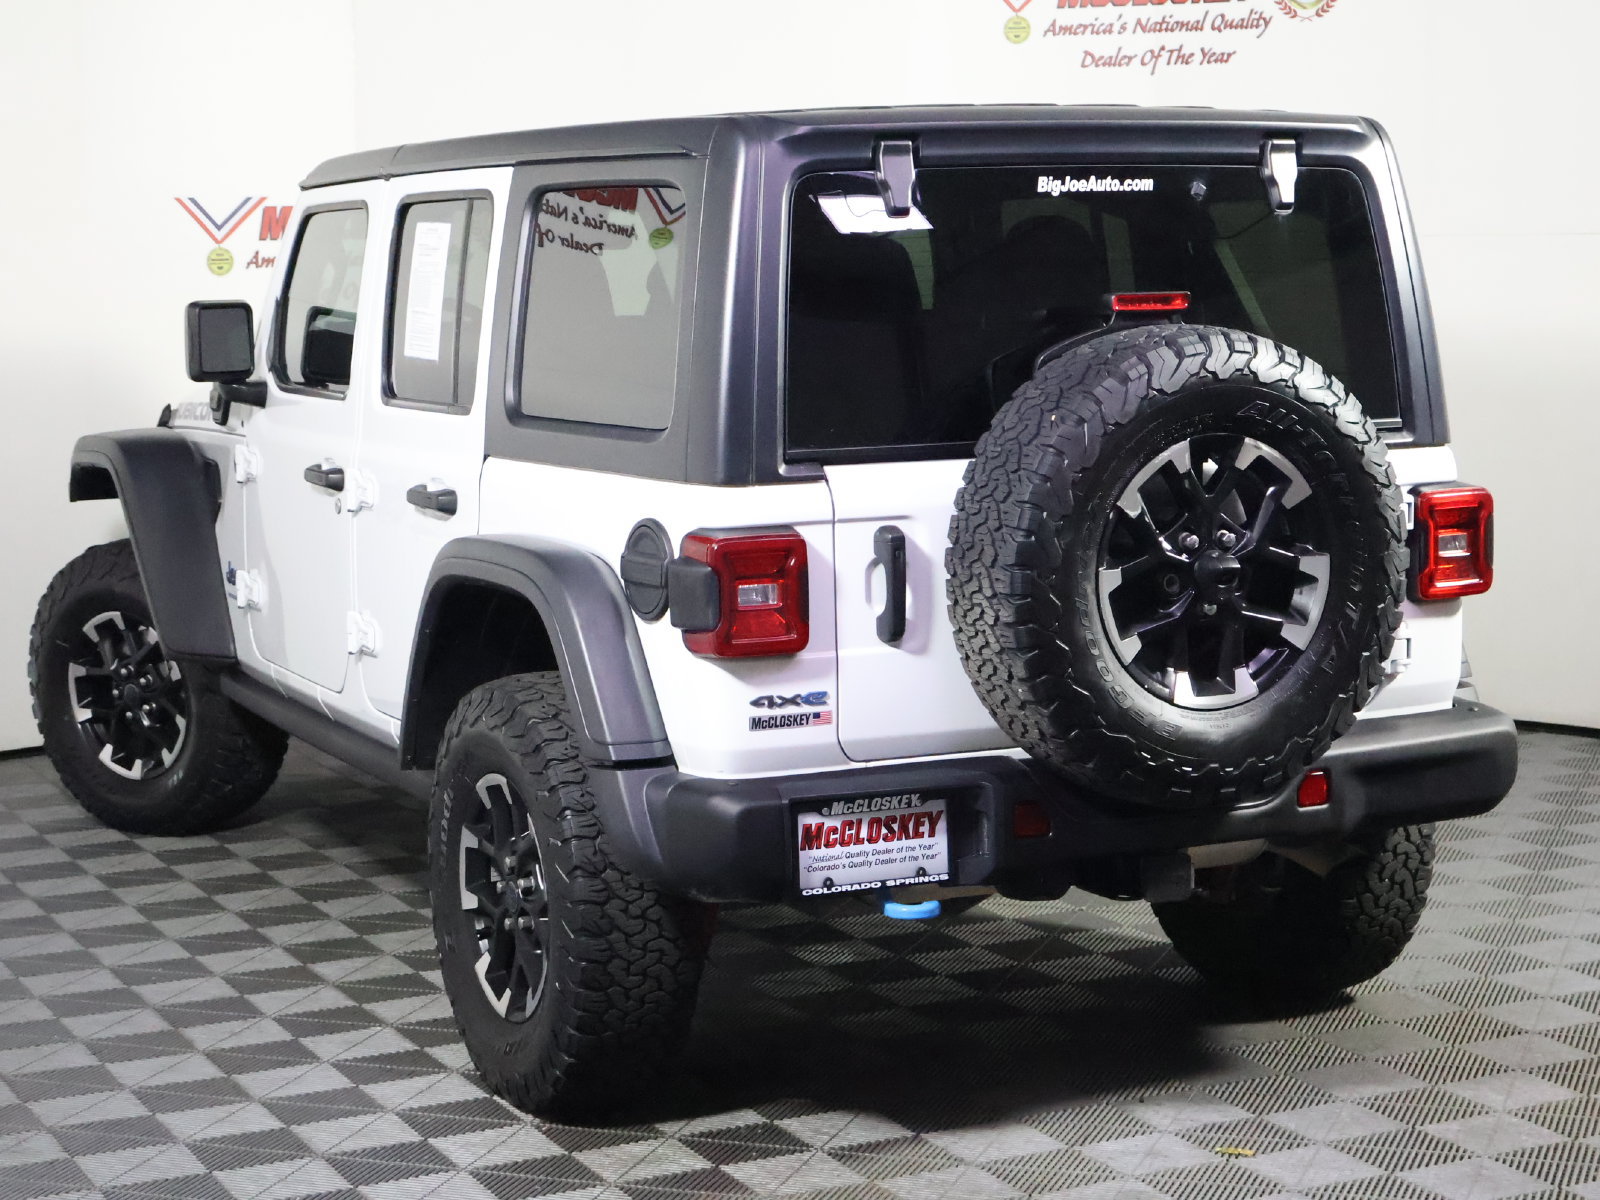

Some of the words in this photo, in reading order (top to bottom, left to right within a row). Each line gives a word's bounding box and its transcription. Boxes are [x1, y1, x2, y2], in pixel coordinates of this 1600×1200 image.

[1043, 13, 1128, 37] America's
[1132, 10, 1210, 34] National
[1210, 7, 1273, 39] Quality
[1080, 47, 1138, 69] Dealer
[1140, 44, 1167, 76] Of
[1166, 44, 1195, 66] The
[1198, 48, 1237, 66] Year
[1036, 175, 1154, 197] BigJoeAuto.com
[751, 713, 812, 730] McCLOSKEY
[830, 793, 921, 815] McCLOSKEY
[800, 810, 944, 851] McCLOSKEY
[844, 849, 870, 860] Quality
[871, 846, 895, 856] Dealer
[895, 845, 905, 854] of
[905, 844, 917, 853] the
[847, 859, 873, 869] Quality
[874, 856, 898, 866] Dealer
[898, 855, 908, 864] of
[908, 854, 919, 863] the
[802, 881, 881, 896] COLORADO
[885, 873, 949, 887] SPRINGS
